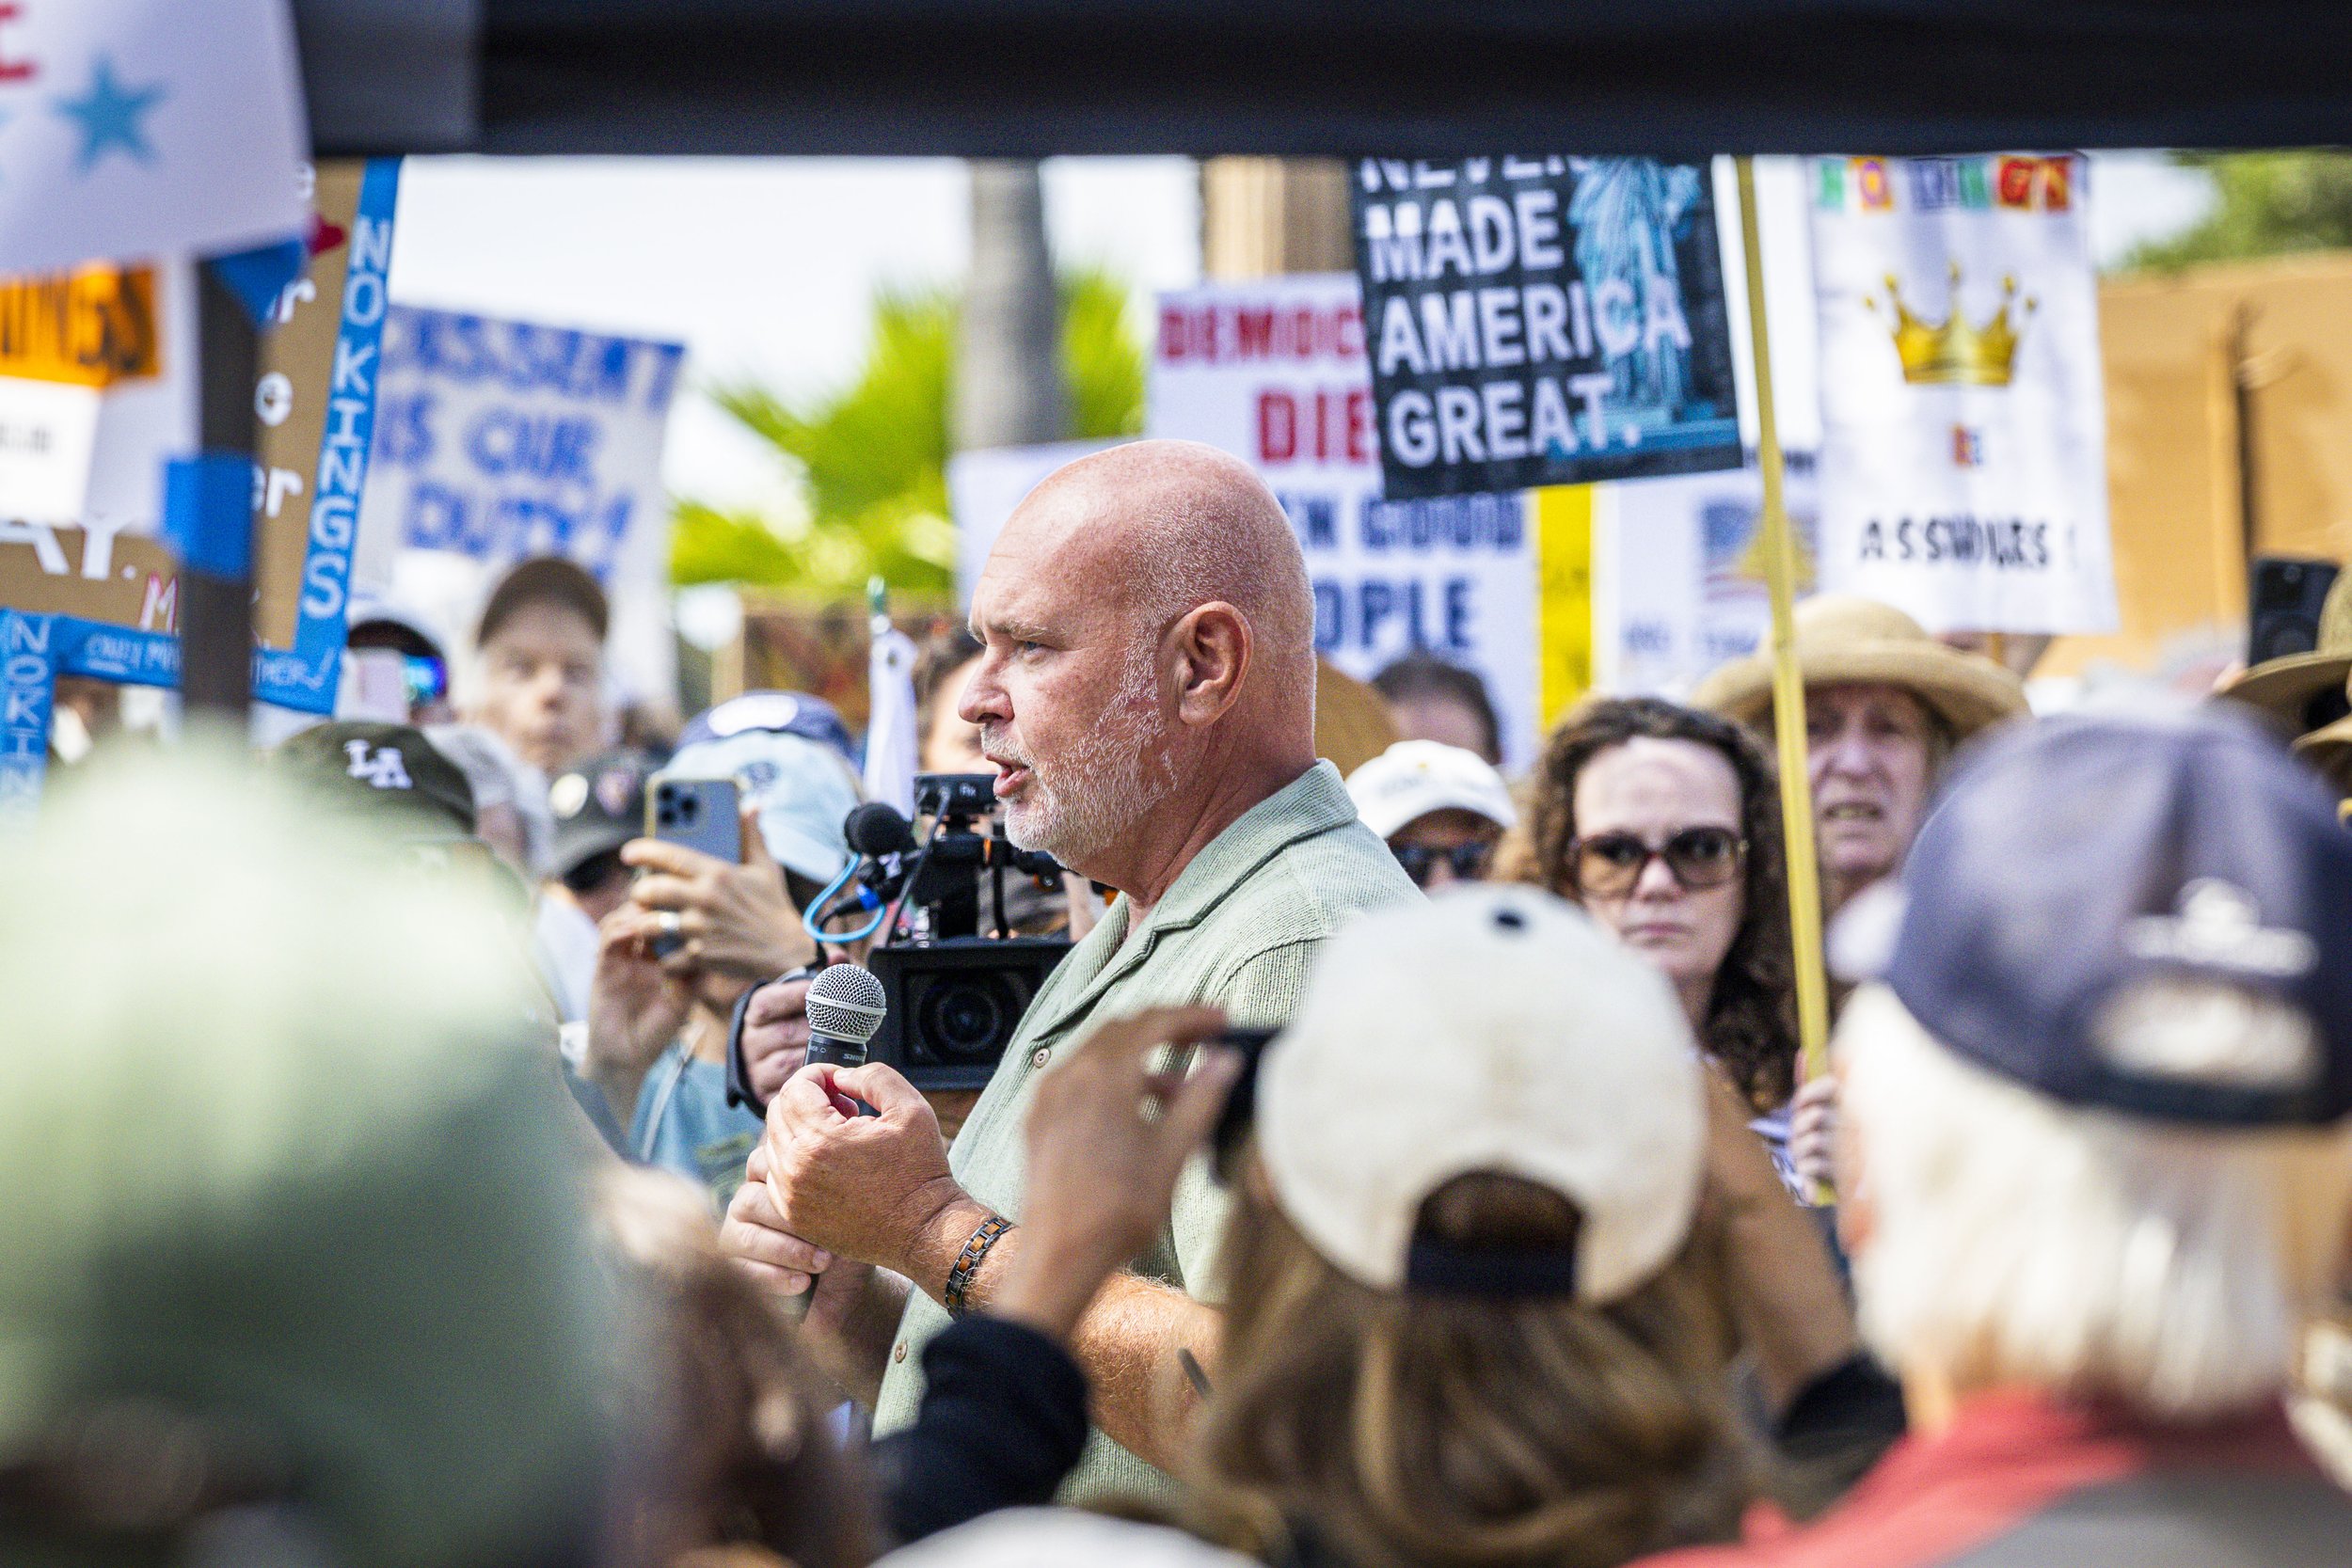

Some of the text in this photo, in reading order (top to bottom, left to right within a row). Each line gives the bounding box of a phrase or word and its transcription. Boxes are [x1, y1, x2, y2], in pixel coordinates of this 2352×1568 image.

[1364, 189, 1565, 280] MADE
[1378, 275, 1692, 376] AMERICA
[301, 214, 392, 618] NO KINGS
[1259, 388, 1375, 463] DIE
[1387, 372, 1642, 468] GREAT.
[1314, 575, 1471, 651] OPLE
[343, 739, 413, 789] LA
